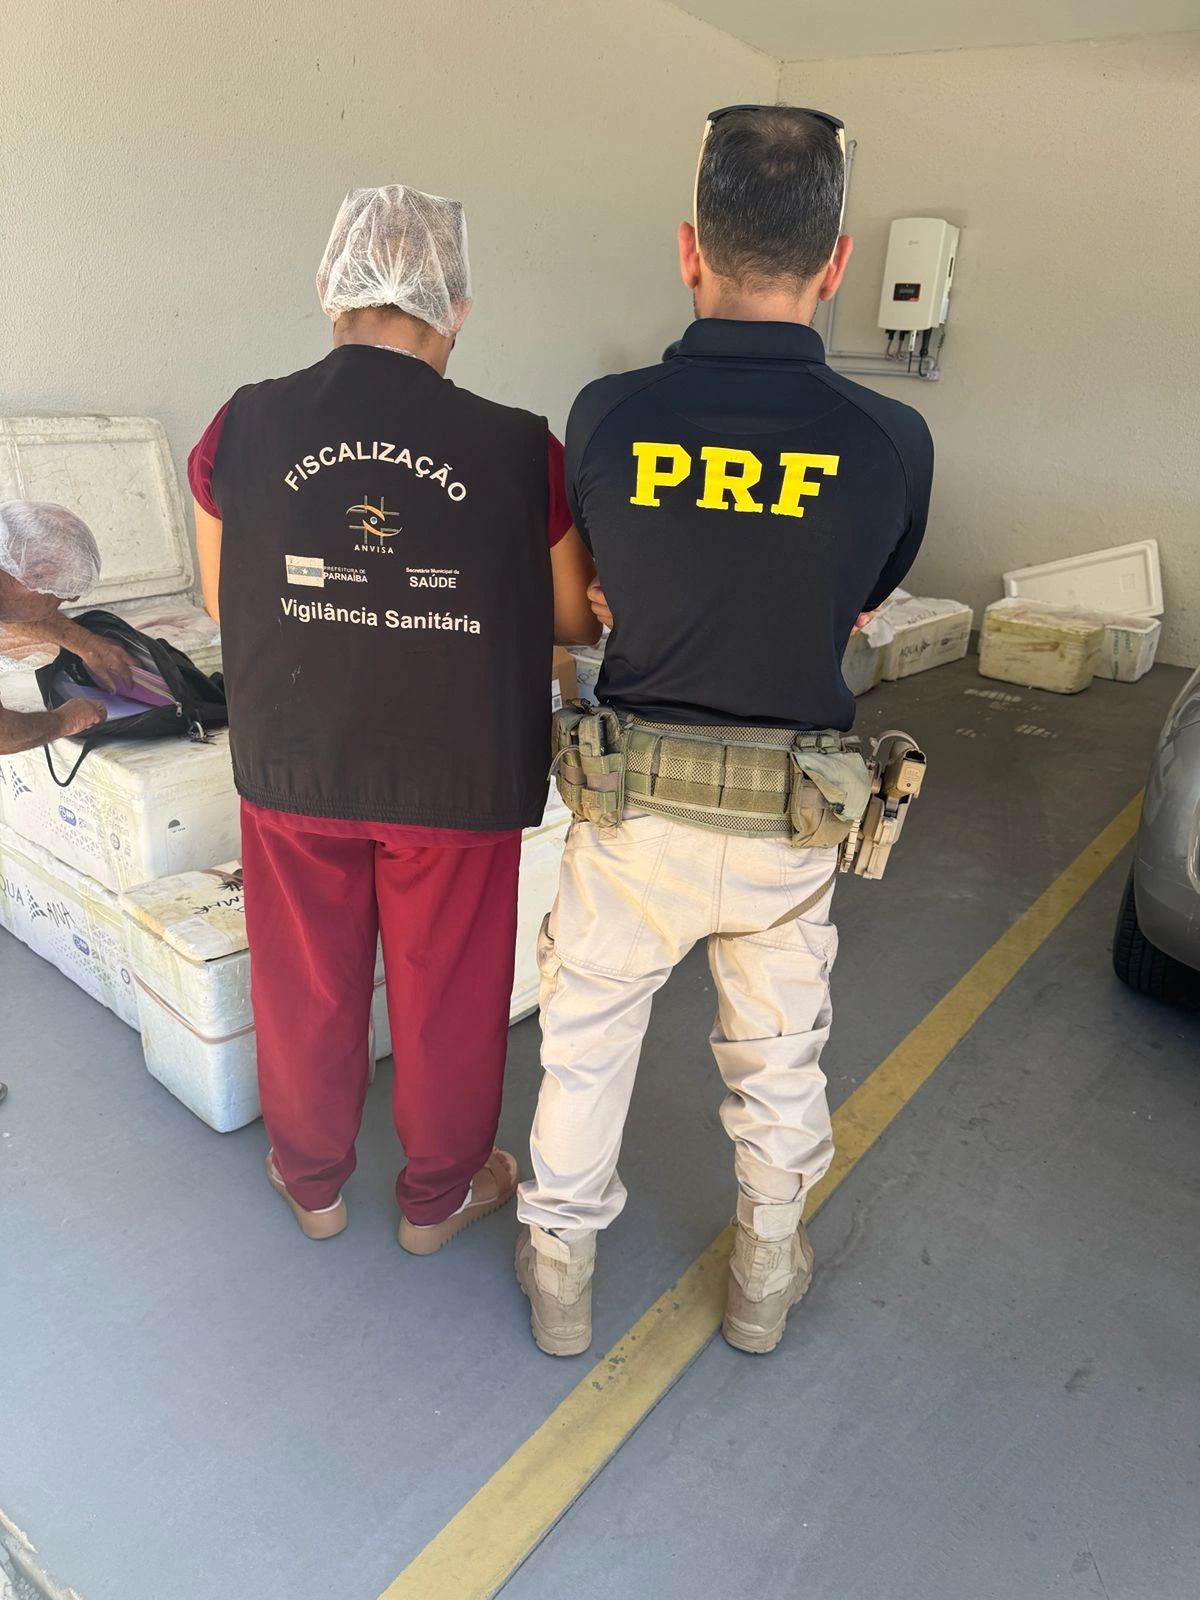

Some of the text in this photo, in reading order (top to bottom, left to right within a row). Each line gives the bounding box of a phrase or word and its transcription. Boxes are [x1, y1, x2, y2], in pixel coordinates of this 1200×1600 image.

[284, 441, 467, 502] FISCALIZAÇÃO
[630, 441, 840, 518] PRF
[354, 544, 394, 554] ANVISA
[323, 571, 369, 583] PARNAÍBA
[430, 567, 452, 575] Municipal
[409, 573, 457, 589] SAÚDE
[281, 597, 481, 635] Vigilância Sanitária
